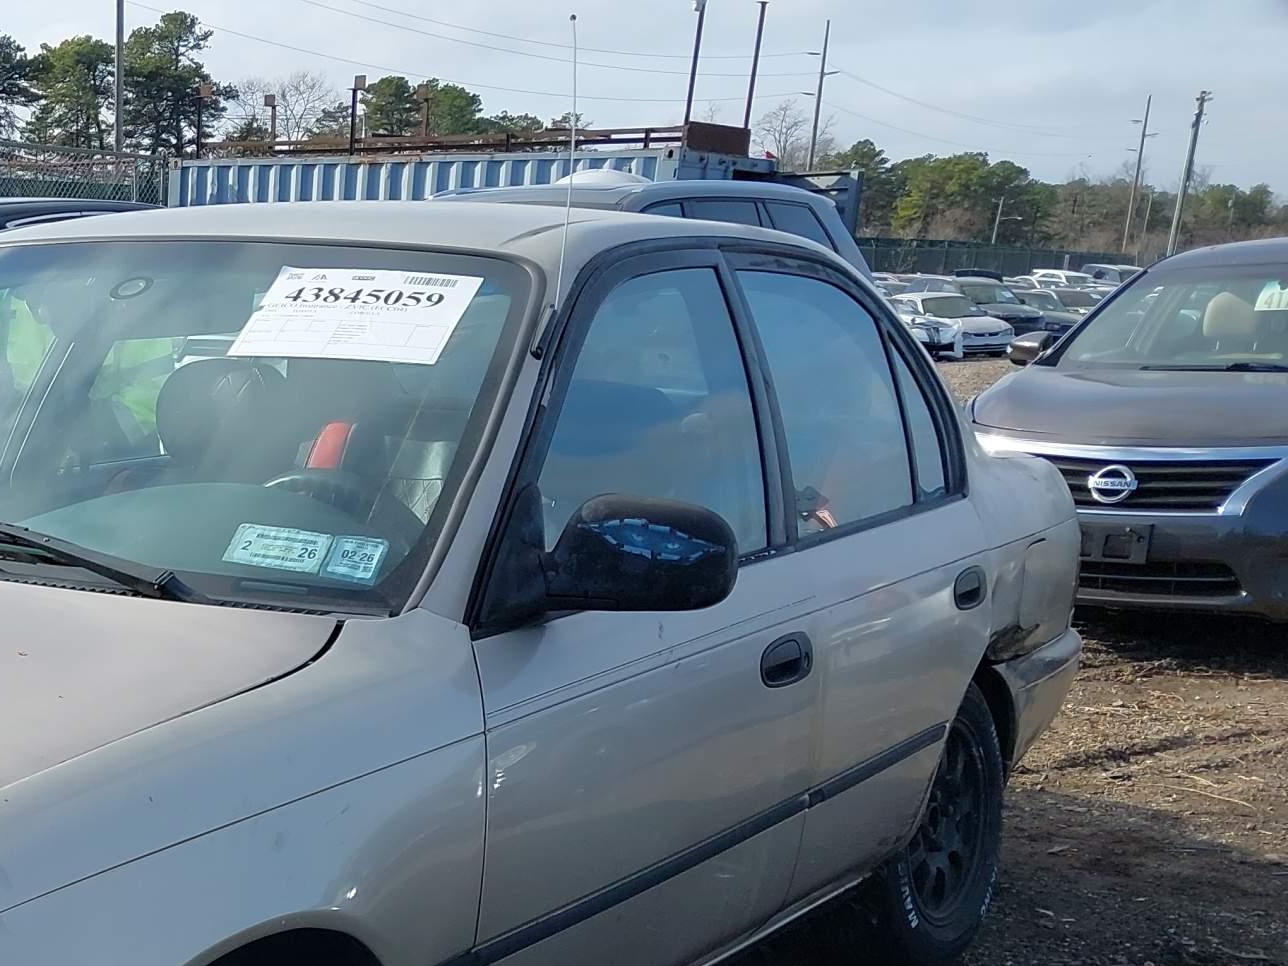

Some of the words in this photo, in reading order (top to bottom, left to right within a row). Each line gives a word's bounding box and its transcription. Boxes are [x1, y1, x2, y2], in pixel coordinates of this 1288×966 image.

[284, 286, 444, 308] 43845059
[1094, 480, 1132, 488] NISSAN
[241, 539, 253, 551] 2
[298, 547, 318, 560] 26
